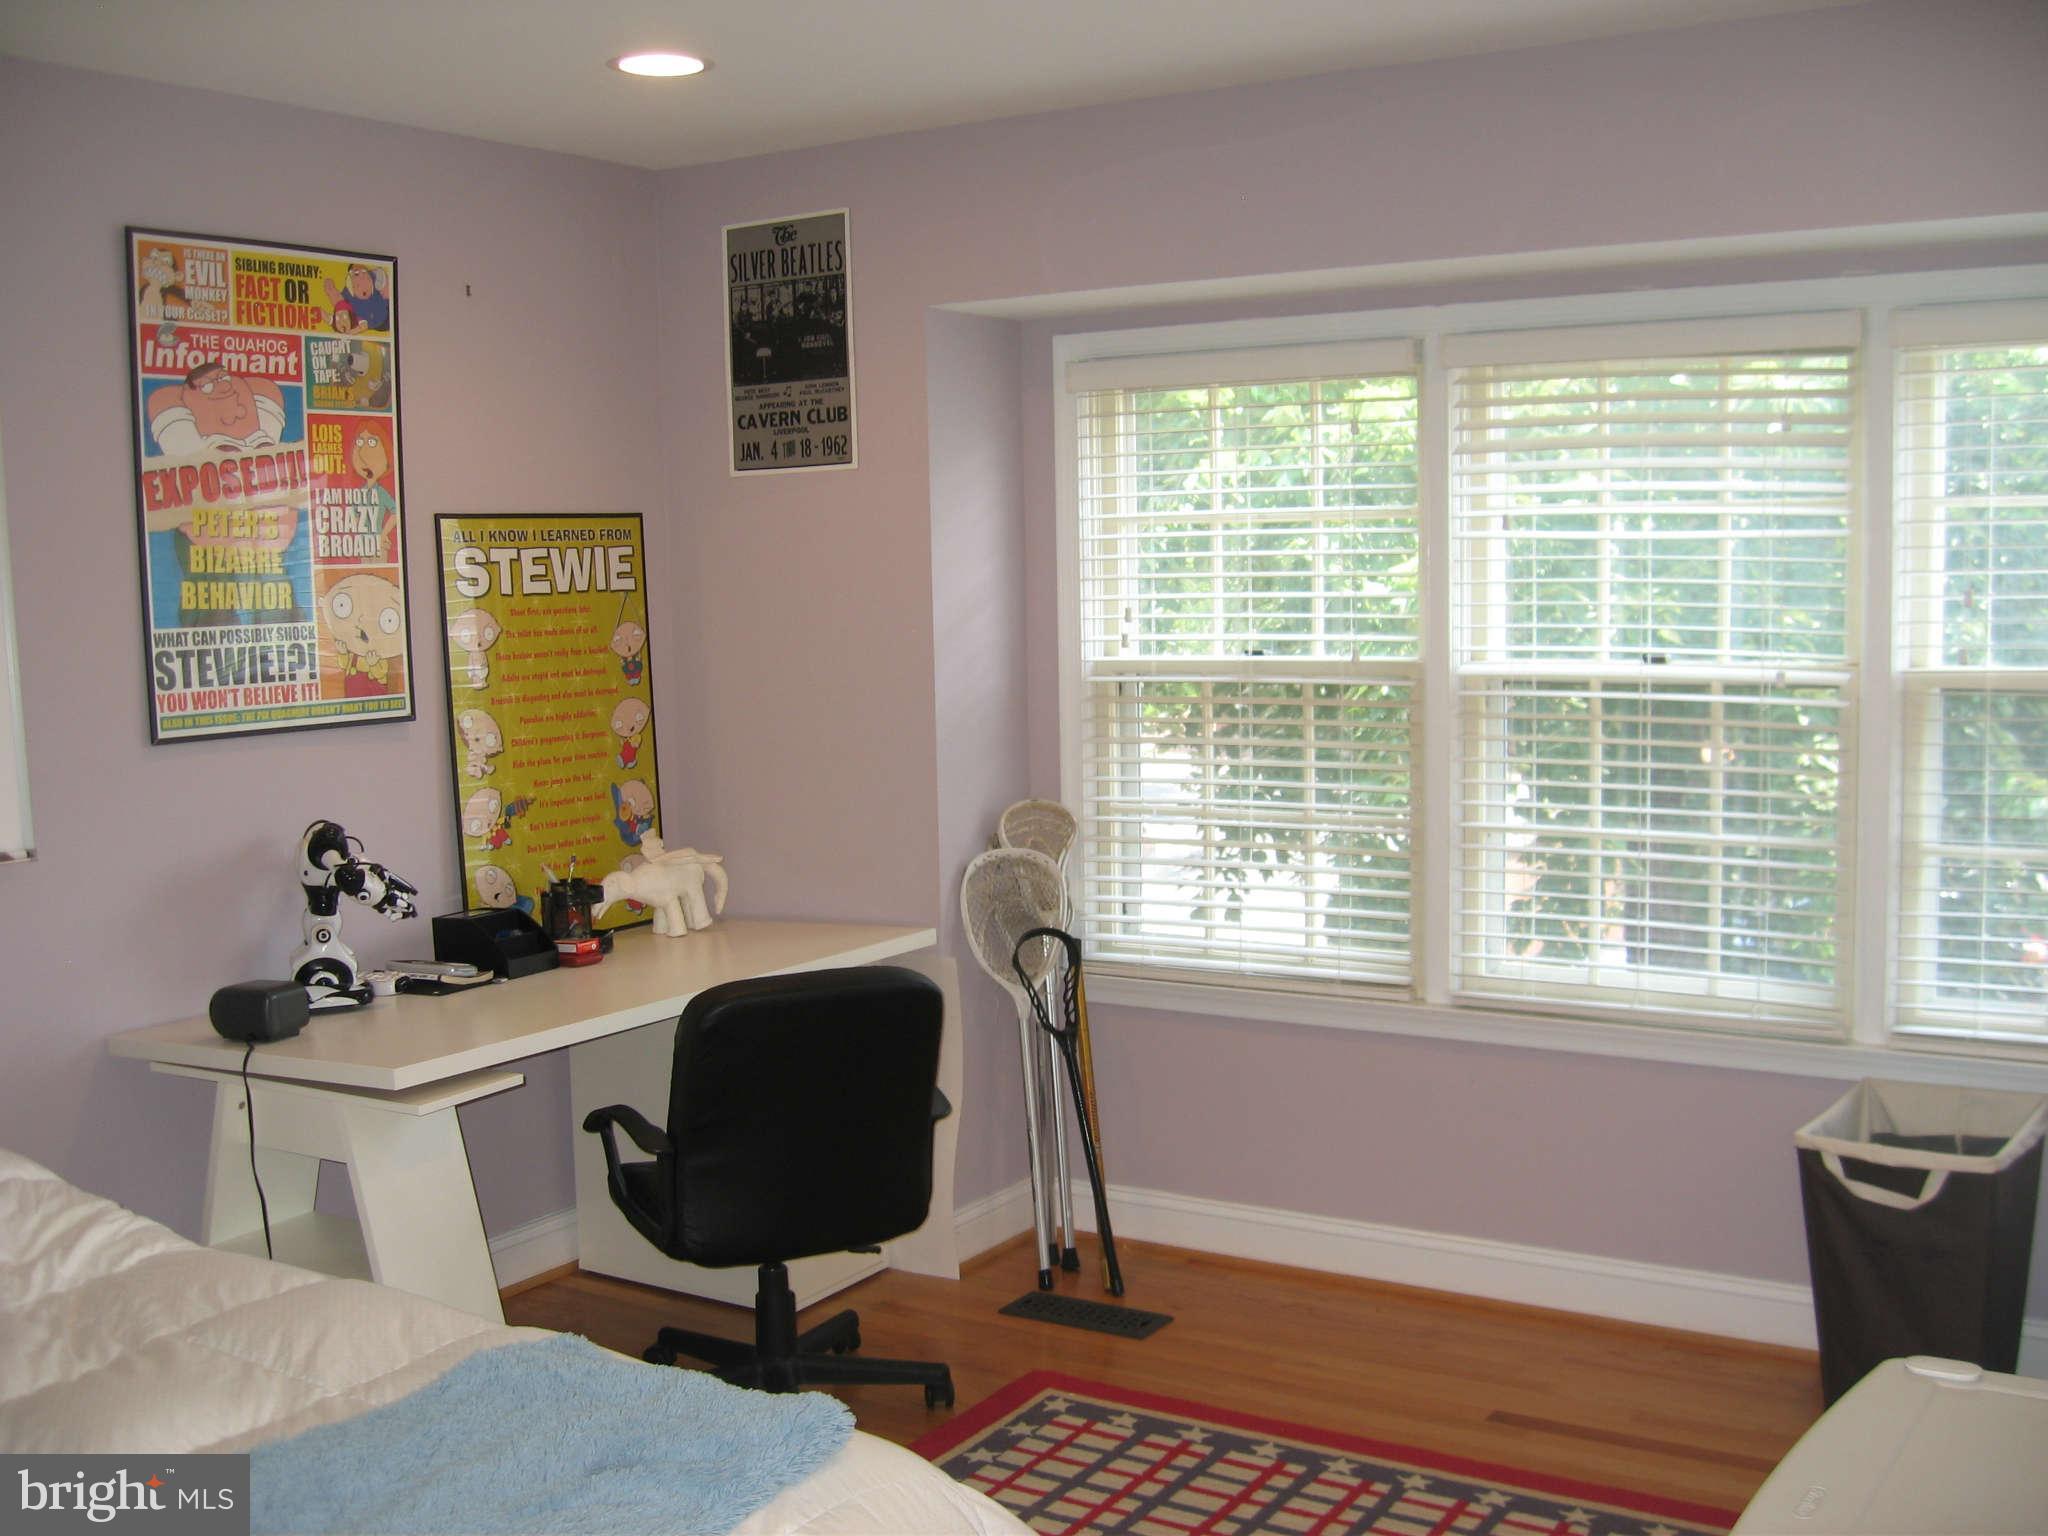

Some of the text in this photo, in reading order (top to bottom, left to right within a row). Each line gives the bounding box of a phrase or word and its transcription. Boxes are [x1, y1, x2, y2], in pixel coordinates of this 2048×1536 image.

[772, 223, 797, 246] The
[185, 259, 226, 288] EVIL
[235, 257, 322, 279] SIBLING RIVALRY:
[730, 240, 843, 283] SILVER BEATLES
[185, 286, 227, 303] MONKEY
[235, 274, 309, 304] FACT OR
[187, 307, 228, 322] CLOSET?
[236, 300, 322, 330] FICTION?
[190, 333, 288, 353] THE QUAHOG
[311, 340, 351, 356] CAUGHT
[144, 340, 299, 376] Informant
[312, 356, 326, 370] ON
[737, 406, 848, 430] CAVERN CLUB
[312, 424, 341, 443] LOIS
[740, 440, 764, 462] JAN.
[771, 441, 778, 460] 4
[142, 450, 308, 513] EXPOSED!!!
[315, 488, 380, 505] I AM NOT A
[192, 508, 280, 541] PETER'S
[315, 505, 380, 535] CRAZY
[319, 534, 382, 558] BROAD!
[453, 528, 632, 543] ALL I KNOW I LEARNED FROM
[189, 544, 283, 575] BIZARRE
[454, 544, 637, 598] STEWIE
[181, 581, 294, 611] BEHAVIOR
[153, 625, 316, 648] WHAT CAN POSSIBLY SHOCK
[154, 643, 318, 692] STEWIE!?!
[157, 682, 320, 714] YOU WON'T BELIEVE IT!
